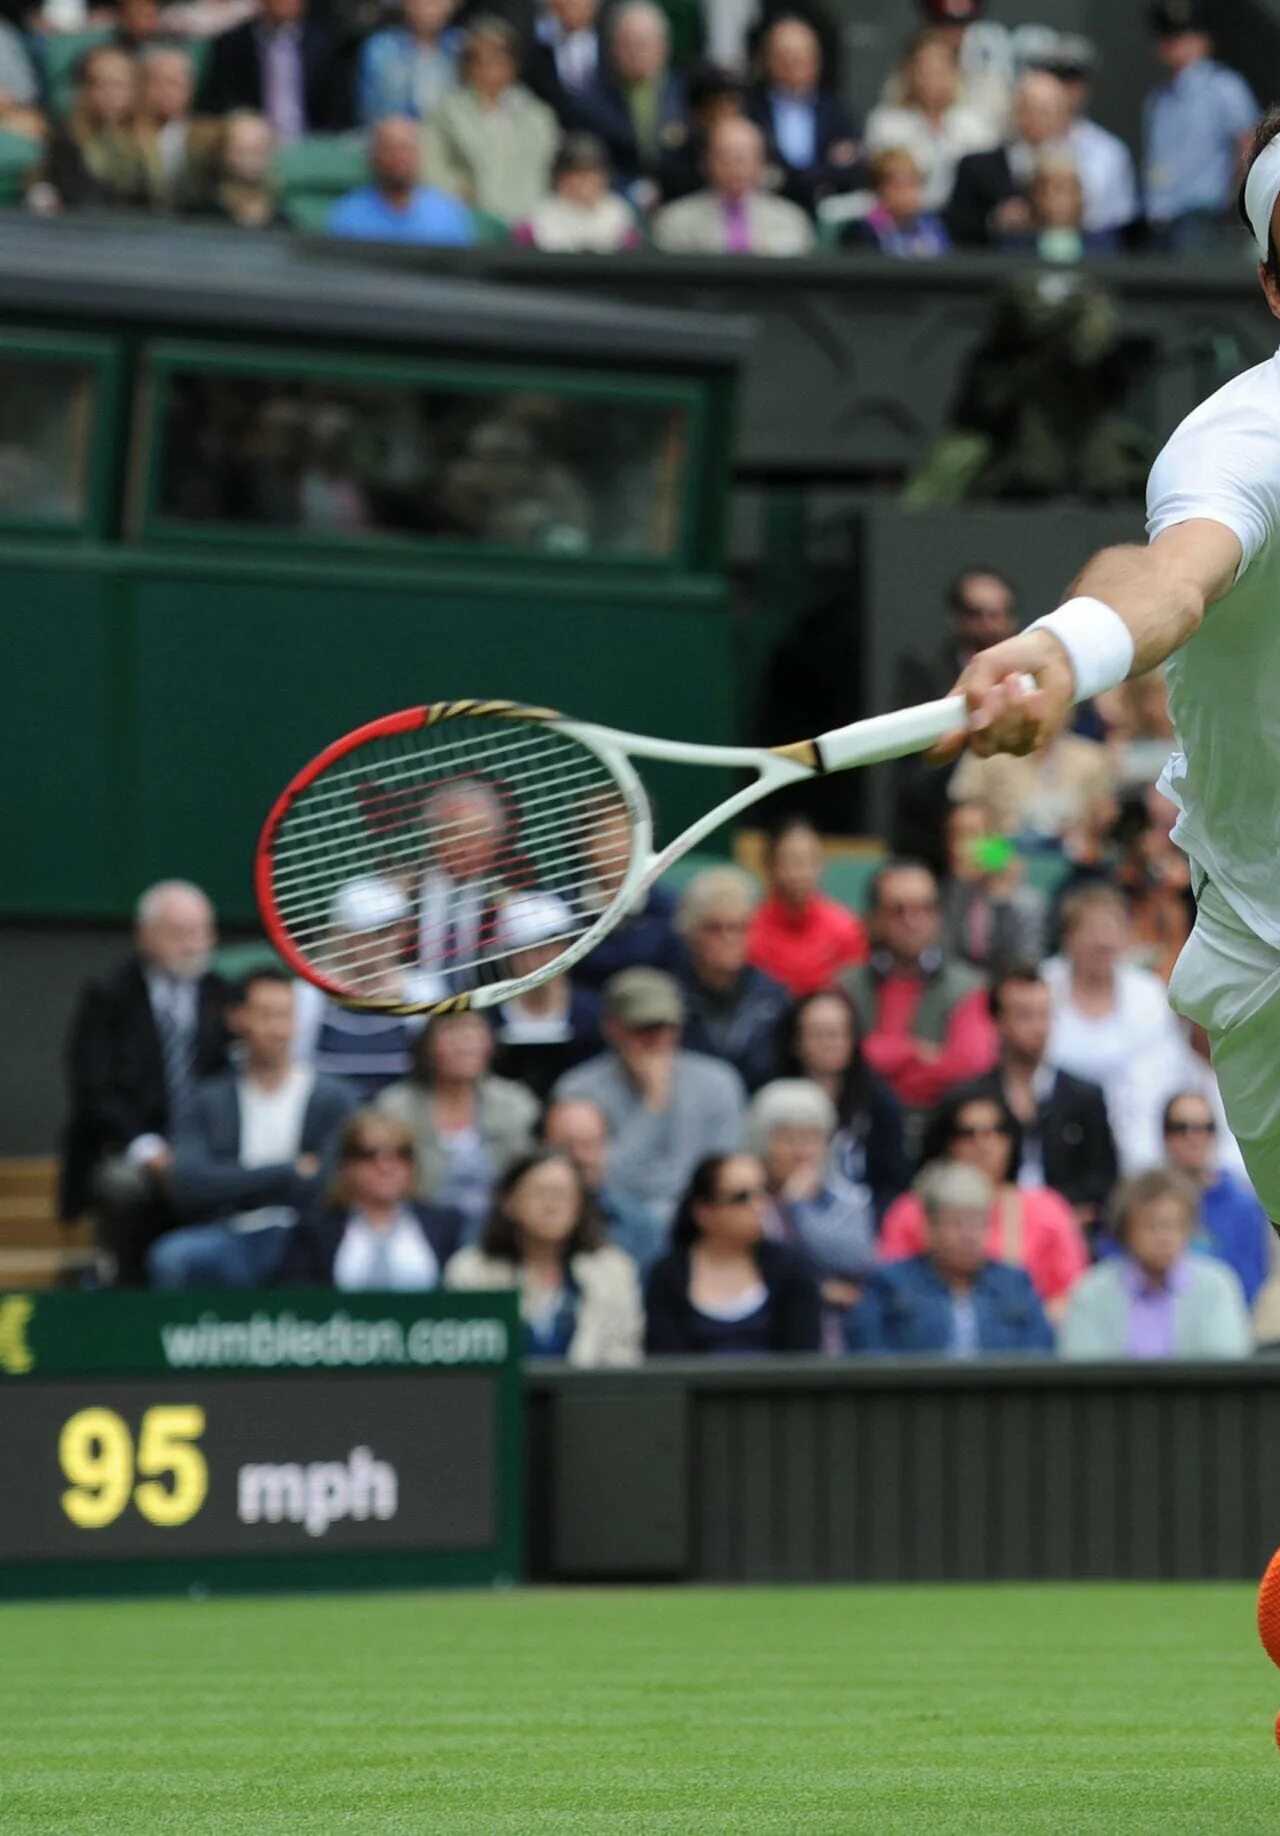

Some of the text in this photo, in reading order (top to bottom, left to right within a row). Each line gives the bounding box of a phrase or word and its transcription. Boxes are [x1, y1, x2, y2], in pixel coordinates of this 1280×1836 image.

[162, 1313, 507, 1367] wimbledon.com
[58, 1404, 398, 1538] 95 mph
